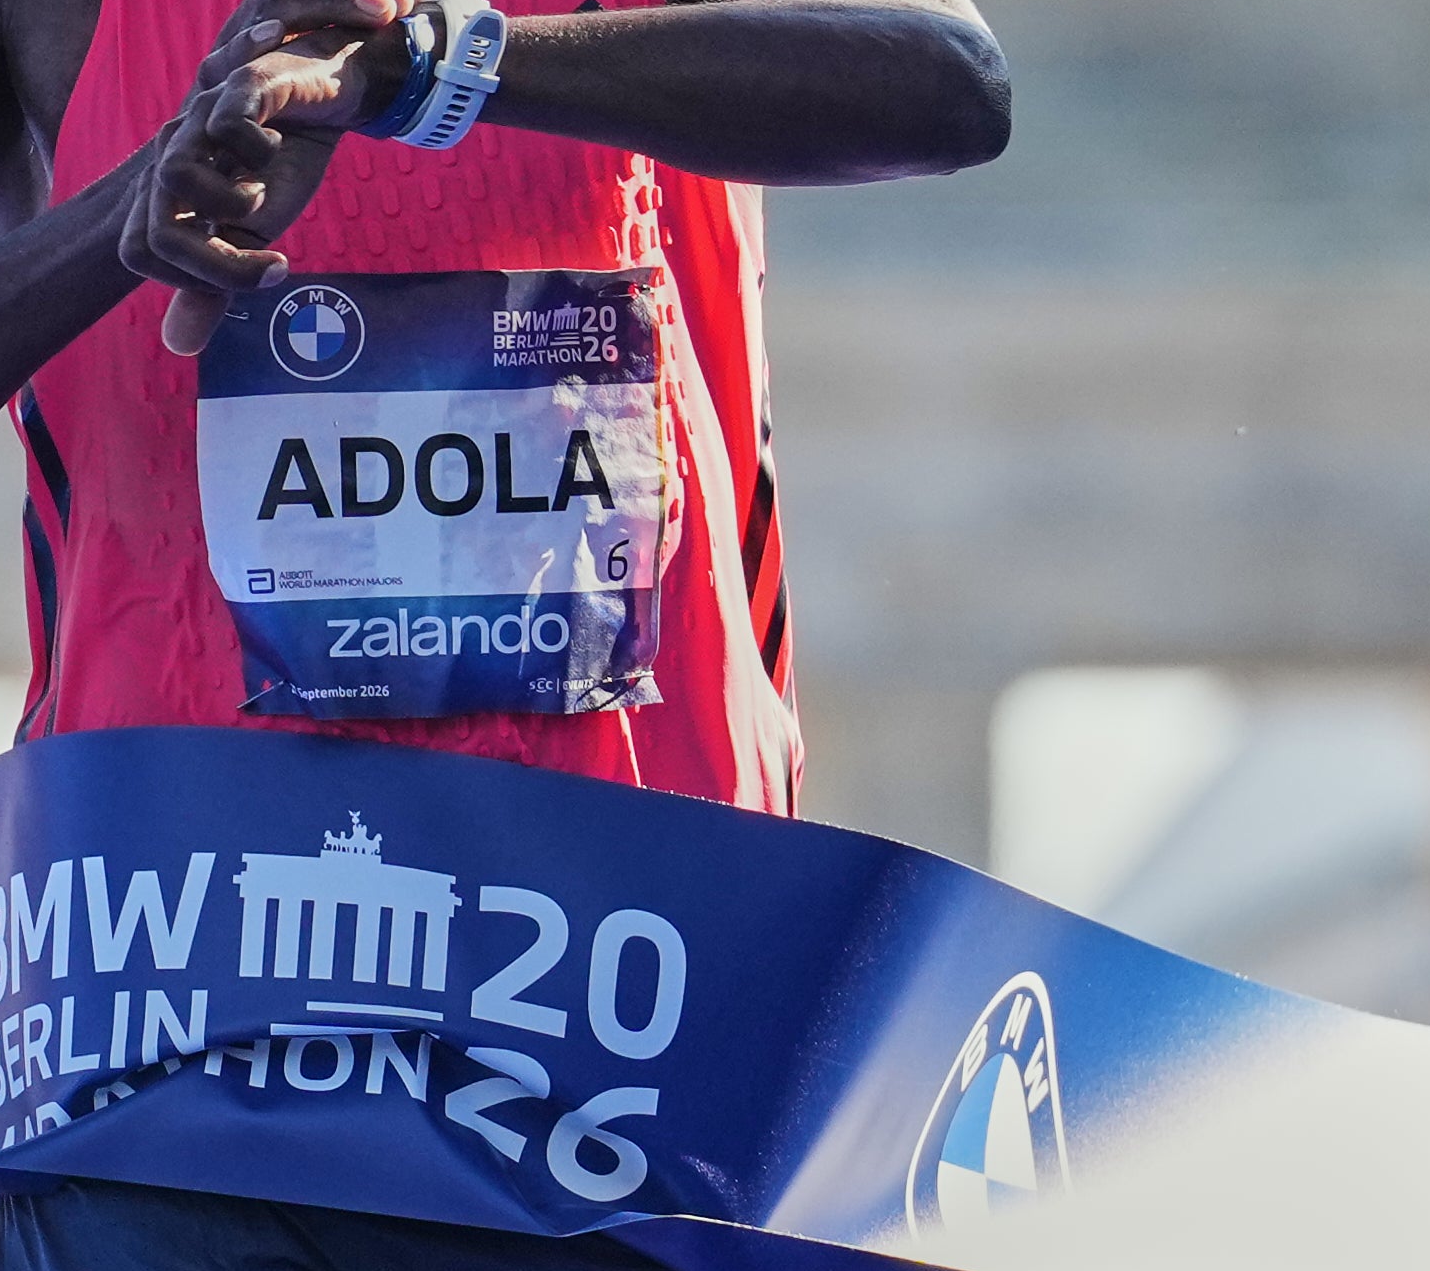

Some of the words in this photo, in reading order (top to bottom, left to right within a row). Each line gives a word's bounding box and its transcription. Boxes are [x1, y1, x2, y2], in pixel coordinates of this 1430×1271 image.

[282, 290, 352, 317] BMW
[493, 309, 552, 333] BMW
[581, 305, 617, 333] 20
[493, 333, 549, 350] BERLIN
[582, 335, 619, 362] 26
[493, 348, 583, 367] MARATHON
[256, 430, 616, 520] ADOLA
[607, 539, 630, 582] 6
[279, 580, 312, 589] WORLD
[313, 578, 365, 588] MARATHON
[327, 604, 570, 659] zalando
[359, 685, 390, 697] 2026
[470, 885, 687, 1060] 20
[960, 993, 1050, 1113] BMW
[445, 1046, 659, 1202] 26
